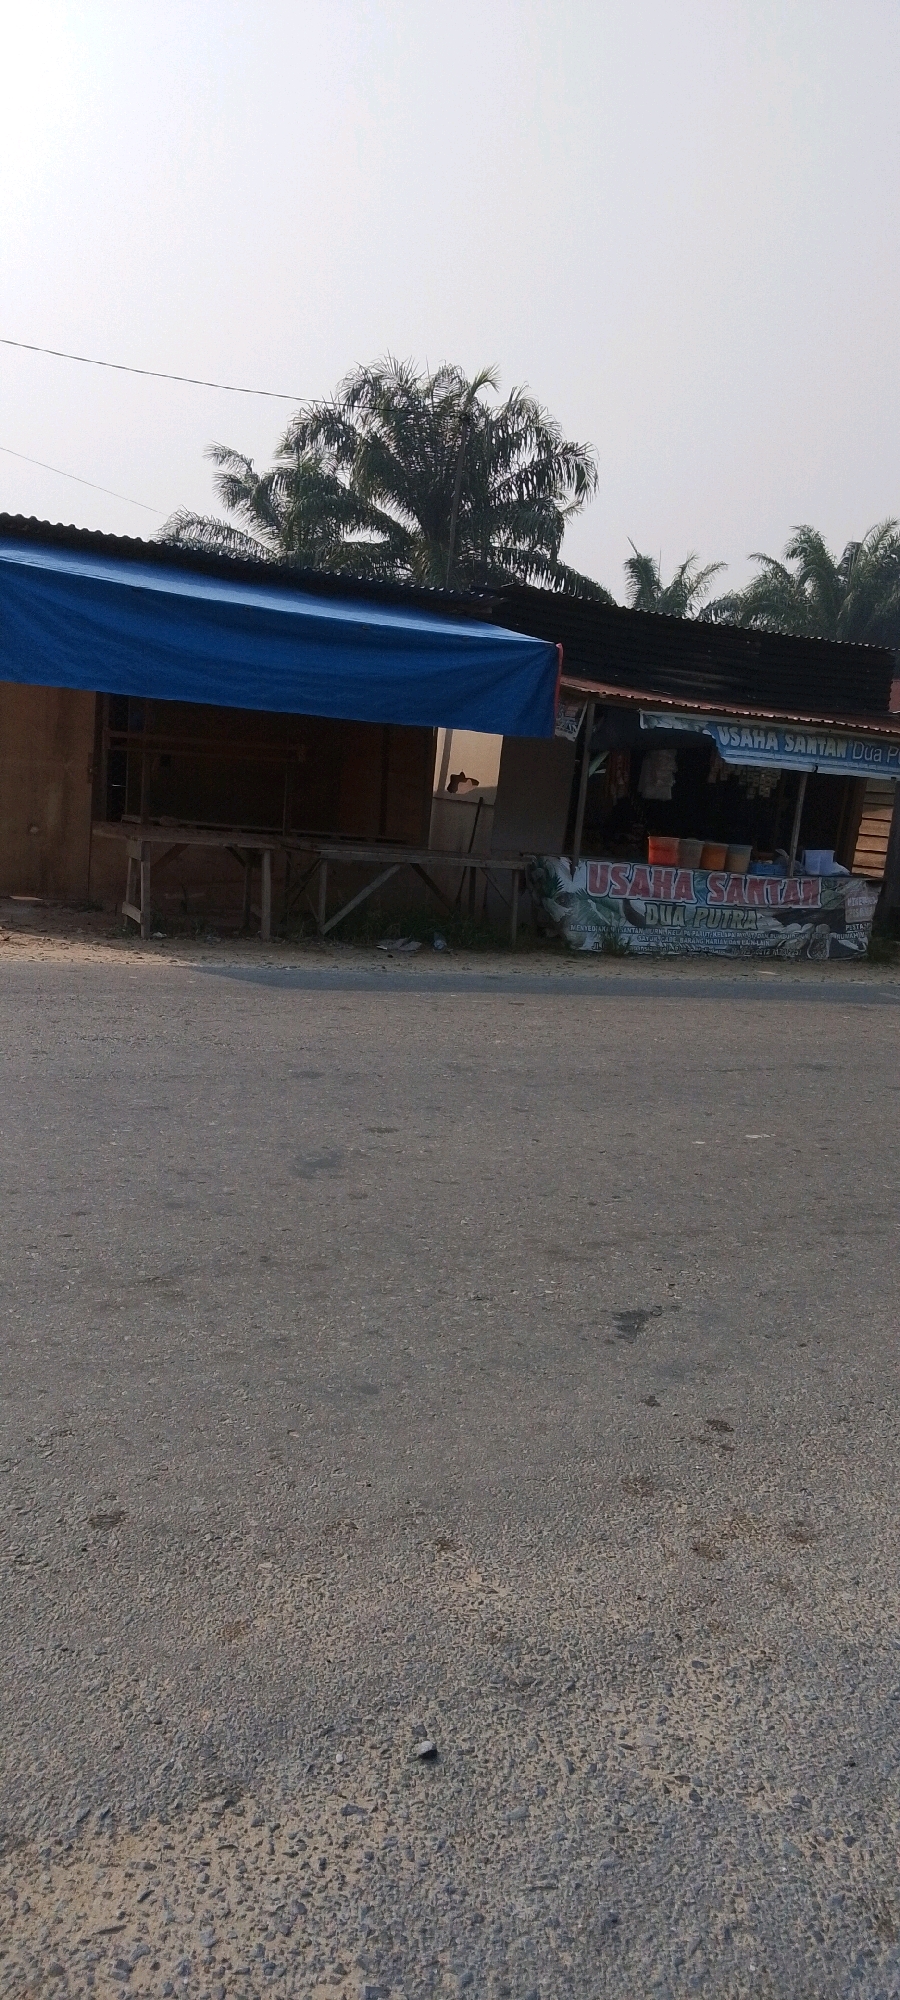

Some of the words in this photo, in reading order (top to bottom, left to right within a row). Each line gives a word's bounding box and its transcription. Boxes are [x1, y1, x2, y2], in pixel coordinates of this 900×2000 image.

[716, 726, 779, 751] USAHA
[784, 733, 848, 759] SANTAN
[852, 741, 882, 763] Dua
[586, 860, 699, 904] USAHA
[706, 872, 822, 908] SANTAN
[644, 902, 687, 927] DUA
[693, 907, 758, 930] PUTRA
